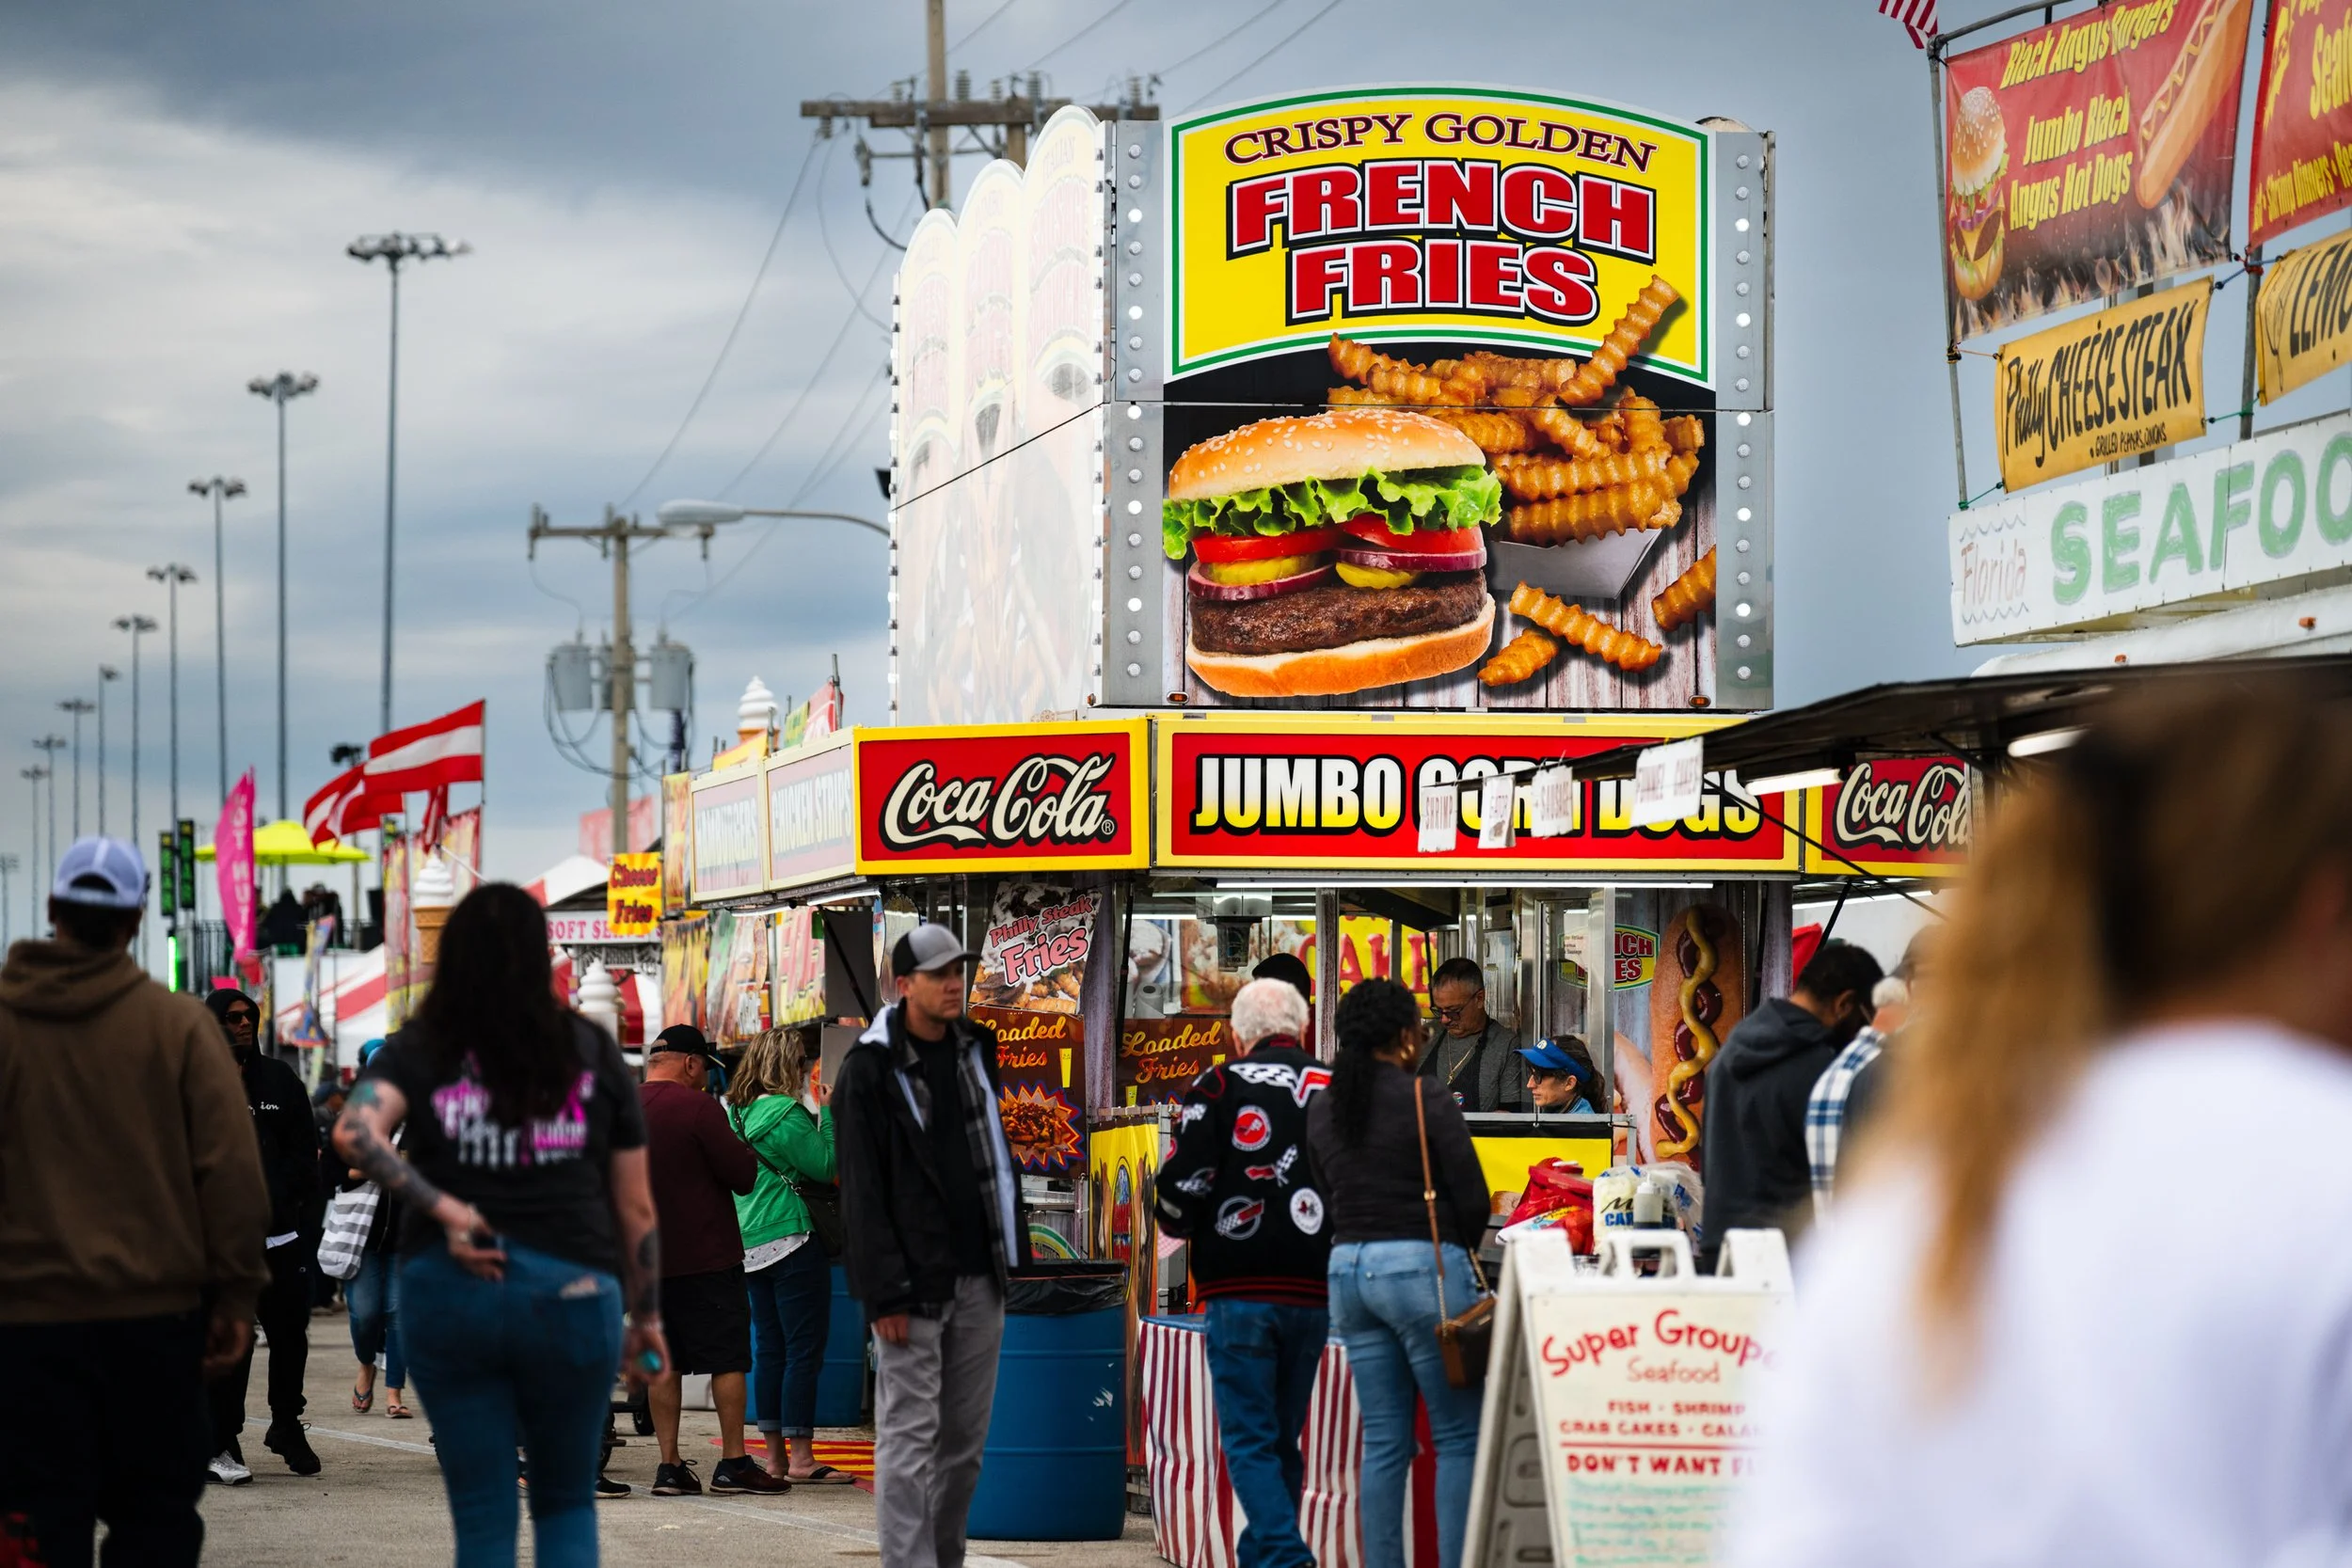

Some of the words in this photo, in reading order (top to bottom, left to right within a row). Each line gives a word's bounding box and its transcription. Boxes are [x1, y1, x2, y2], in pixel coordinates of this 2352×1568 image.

[2000, 25, 2051, 90] Black
[2049, 19, 2110, 75] Angus
[2110, 1, 2174, 55] Burgers
[2310, 7, 2352, 120] Seaf
[1224, 113, 1413, 166] CRISPY
[1424, 112, 1658, 175] GOLDEN
[2023, 105, 2084, 166] Jumbo
[2084, 85, 2130, 149] Black
[1227, 157, 1657, 265] FRENCH
[2010, 176, 2060, 232] Angus
[2060, 157, 2092, 215] Hot
[2091, 151, 2134, 209] Dogs
[2293, 155, 2335, 209] Dinners
[1286, 236, 1601, 326] FRIES
[2005, 356, 2047, 468] Philly
[1961, 538, 2026, 606] Florida
[771, 779, 815, 855] CHICKEN
[815, 768, 851, 845] STRIPS
[881, 760, 993, 848] Coca
[1192, 754, 1406, 835] JUMBO
[1424, 796, 1454, 831] SHRIMP
[1835, 762, 1910, 847] Coca
[610, 863, 658, 888] Cheese
[547, 920, 587, 940] SOFT
[614, 899, 653, 924] Fries
[989, 915, 1040, 948] Philly
[1041, 895, 1093, 926] Steak
[1000, 925, 1091, 988] Fries
[995, 1045, 1048, 1069] Fries
[1120, 1020, 1223, 1059] Loaded
[1135, 1054, 1200, 1084] Fries
[1541, 1323, 1641, 1377] Super
[1626, 1356, 1722, 1385] Seafood
[1559, 1420, 1611, 1434] CRAB
[1617, 1421, 1680, 1436] CAKES
[1701, 1423, 1765, 1438] CALA
[1607, 1401, 1651, 1414] FISH
[1672, 1402, 1746, 1417] SHRIMP
[1566, 1454, 1641, 1474] DON'T
[1650, 1455, 1722, 1475] WANT
